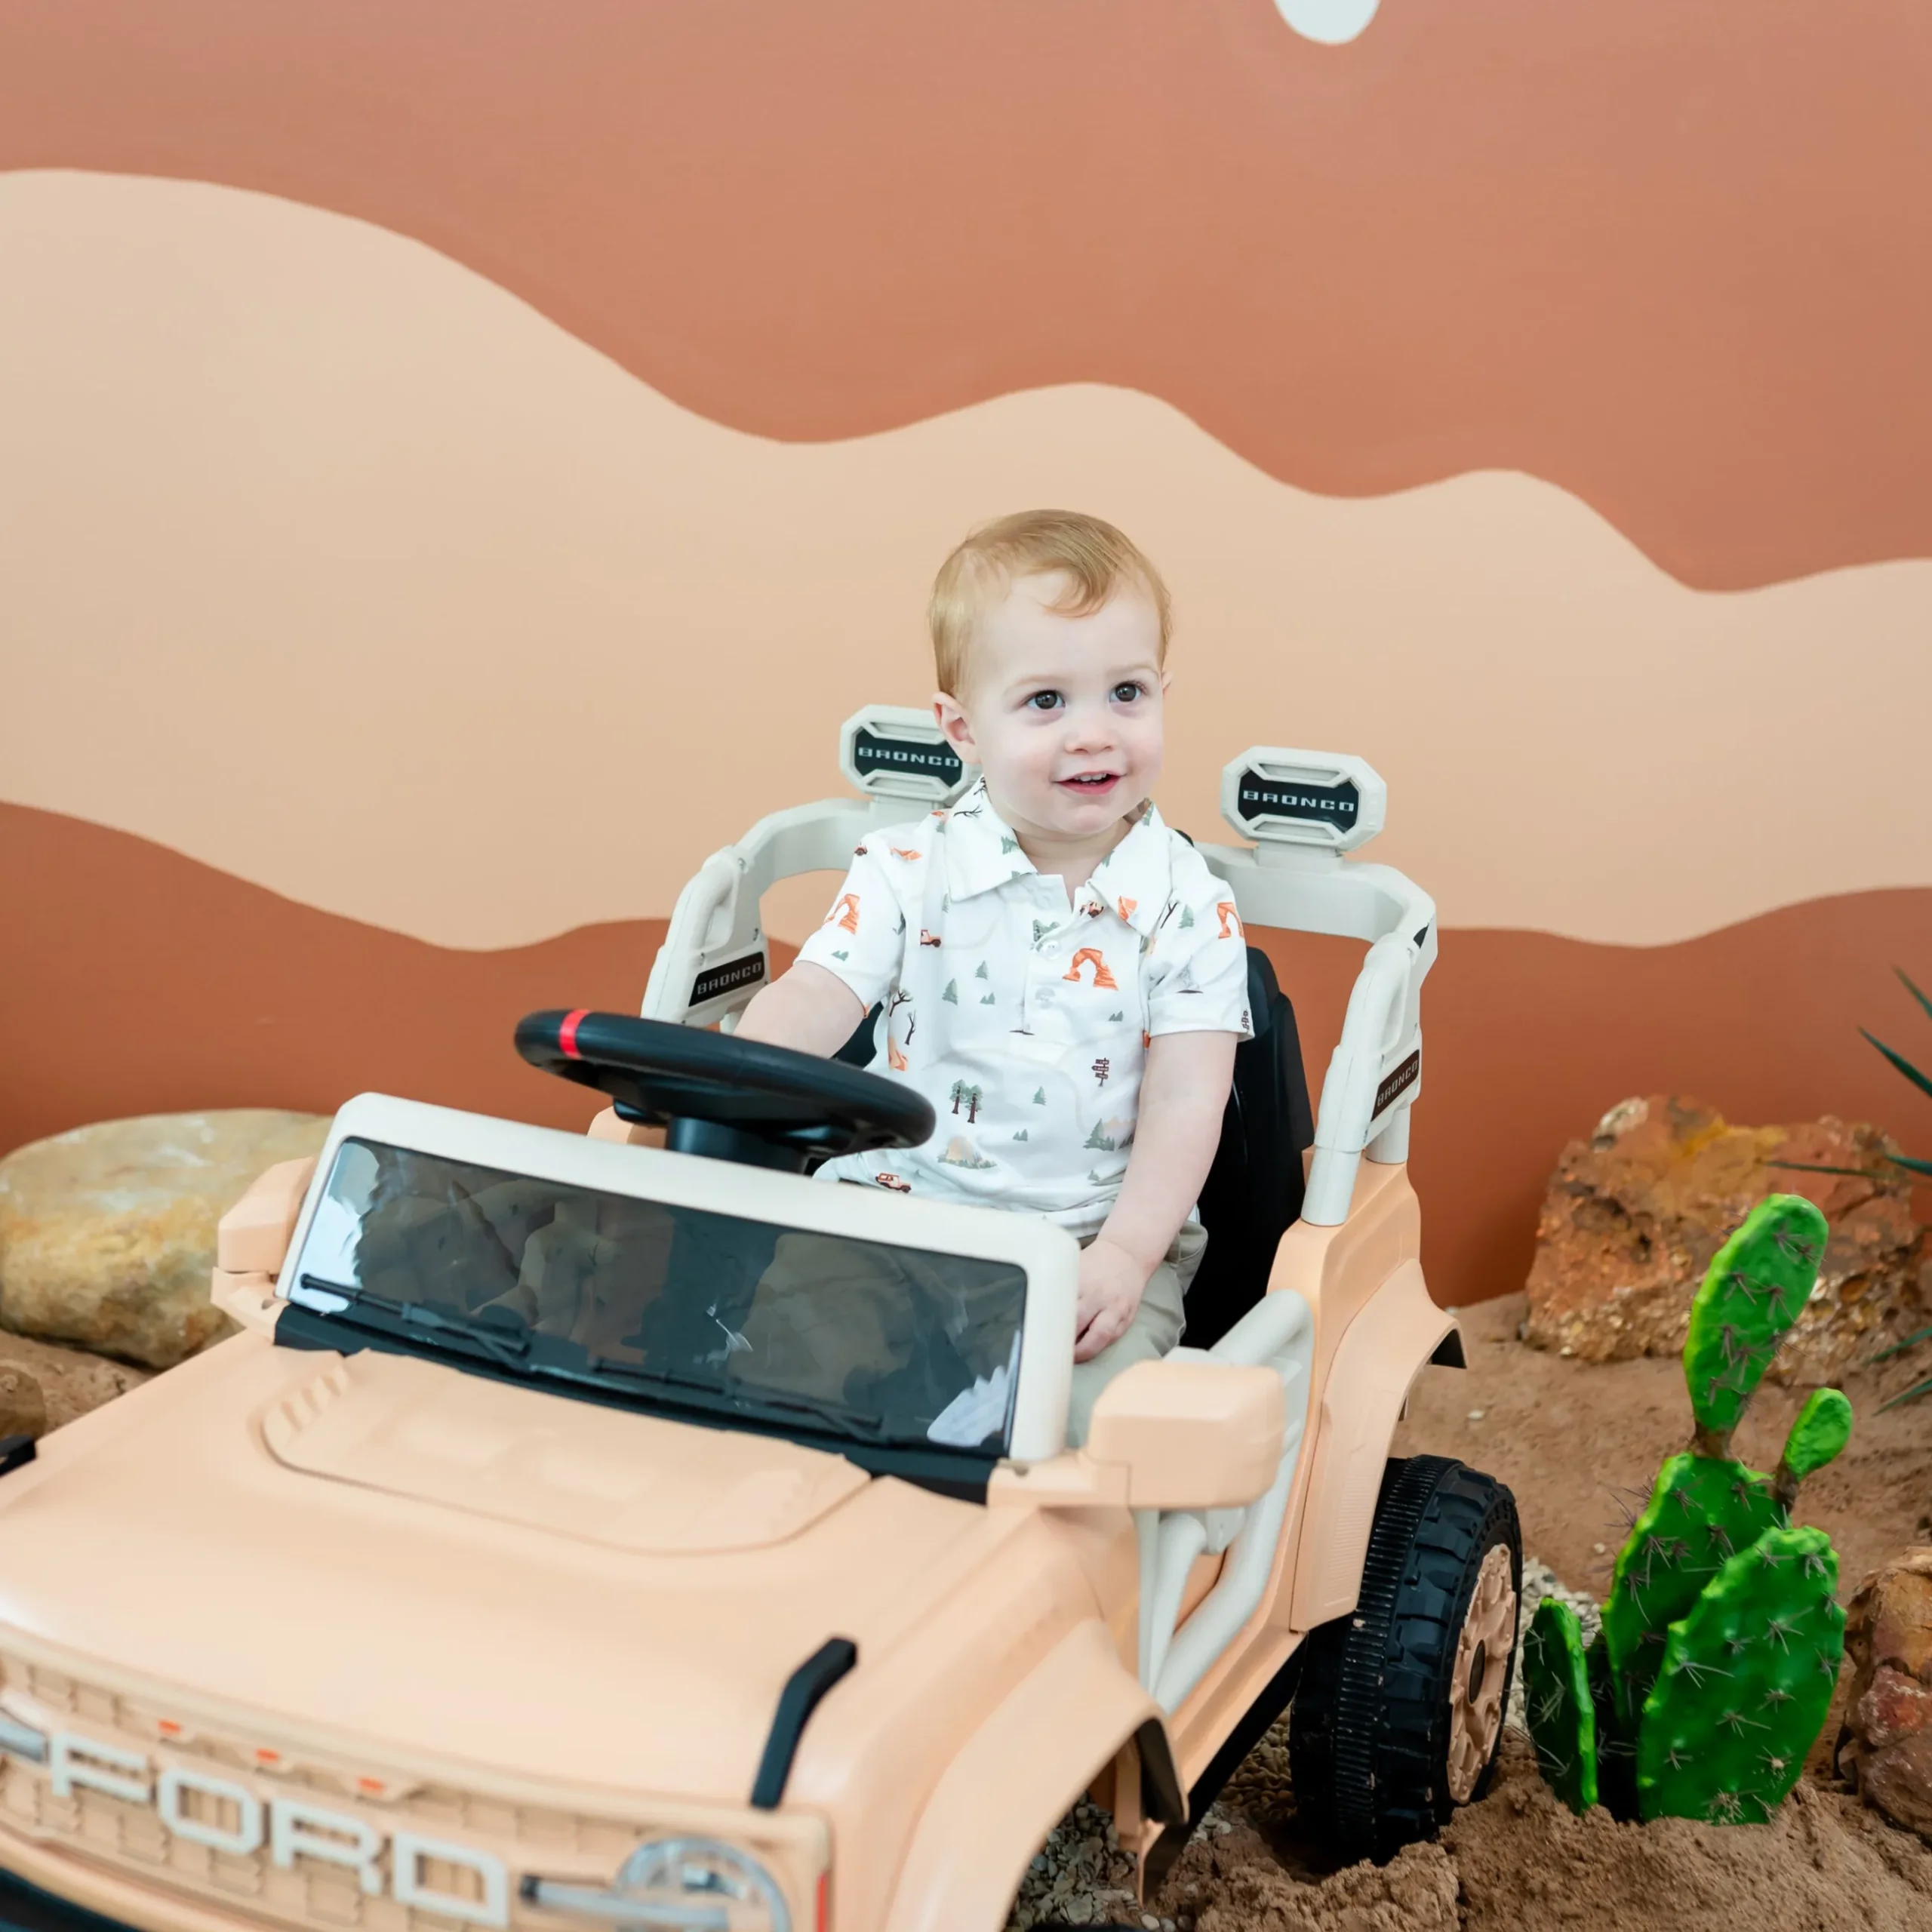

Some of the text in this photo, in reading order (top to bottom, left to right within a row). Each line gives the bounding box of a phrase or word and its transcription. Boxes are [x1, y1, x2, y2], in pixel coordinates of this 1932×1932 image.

[858, 746, 959, 768] BRONCO
[1243, 790, 1355, 812] BRONCO
[697, 961, 761, 995] BRONCO
[1377, 1060, 1418, 1107] BRONCO
[51, 1733, 509, 1928] FORD
